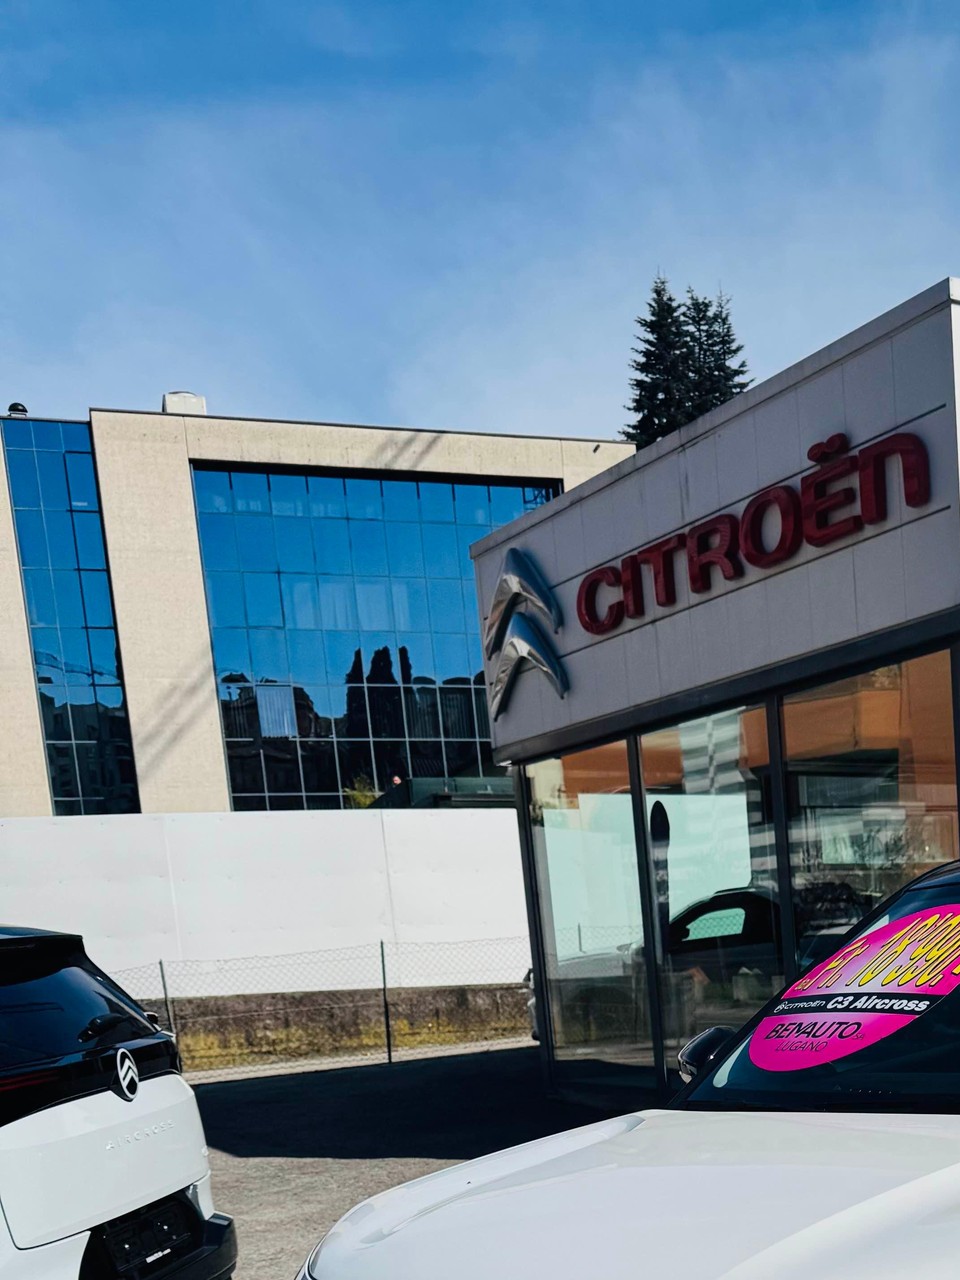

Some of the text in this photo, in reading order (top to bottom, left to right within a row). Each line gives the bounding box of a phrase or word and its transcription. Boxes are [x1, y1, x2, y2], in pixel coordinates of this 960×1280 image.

[576, 433, 931, 635] CITROËN
[826, 996, 850, 1010] C3
[850, 996, 930, 1012] Aircross
[775, 1041, 828, 1052] LUGANO
[105, 1120, 175, 1151] AIRCROSS
